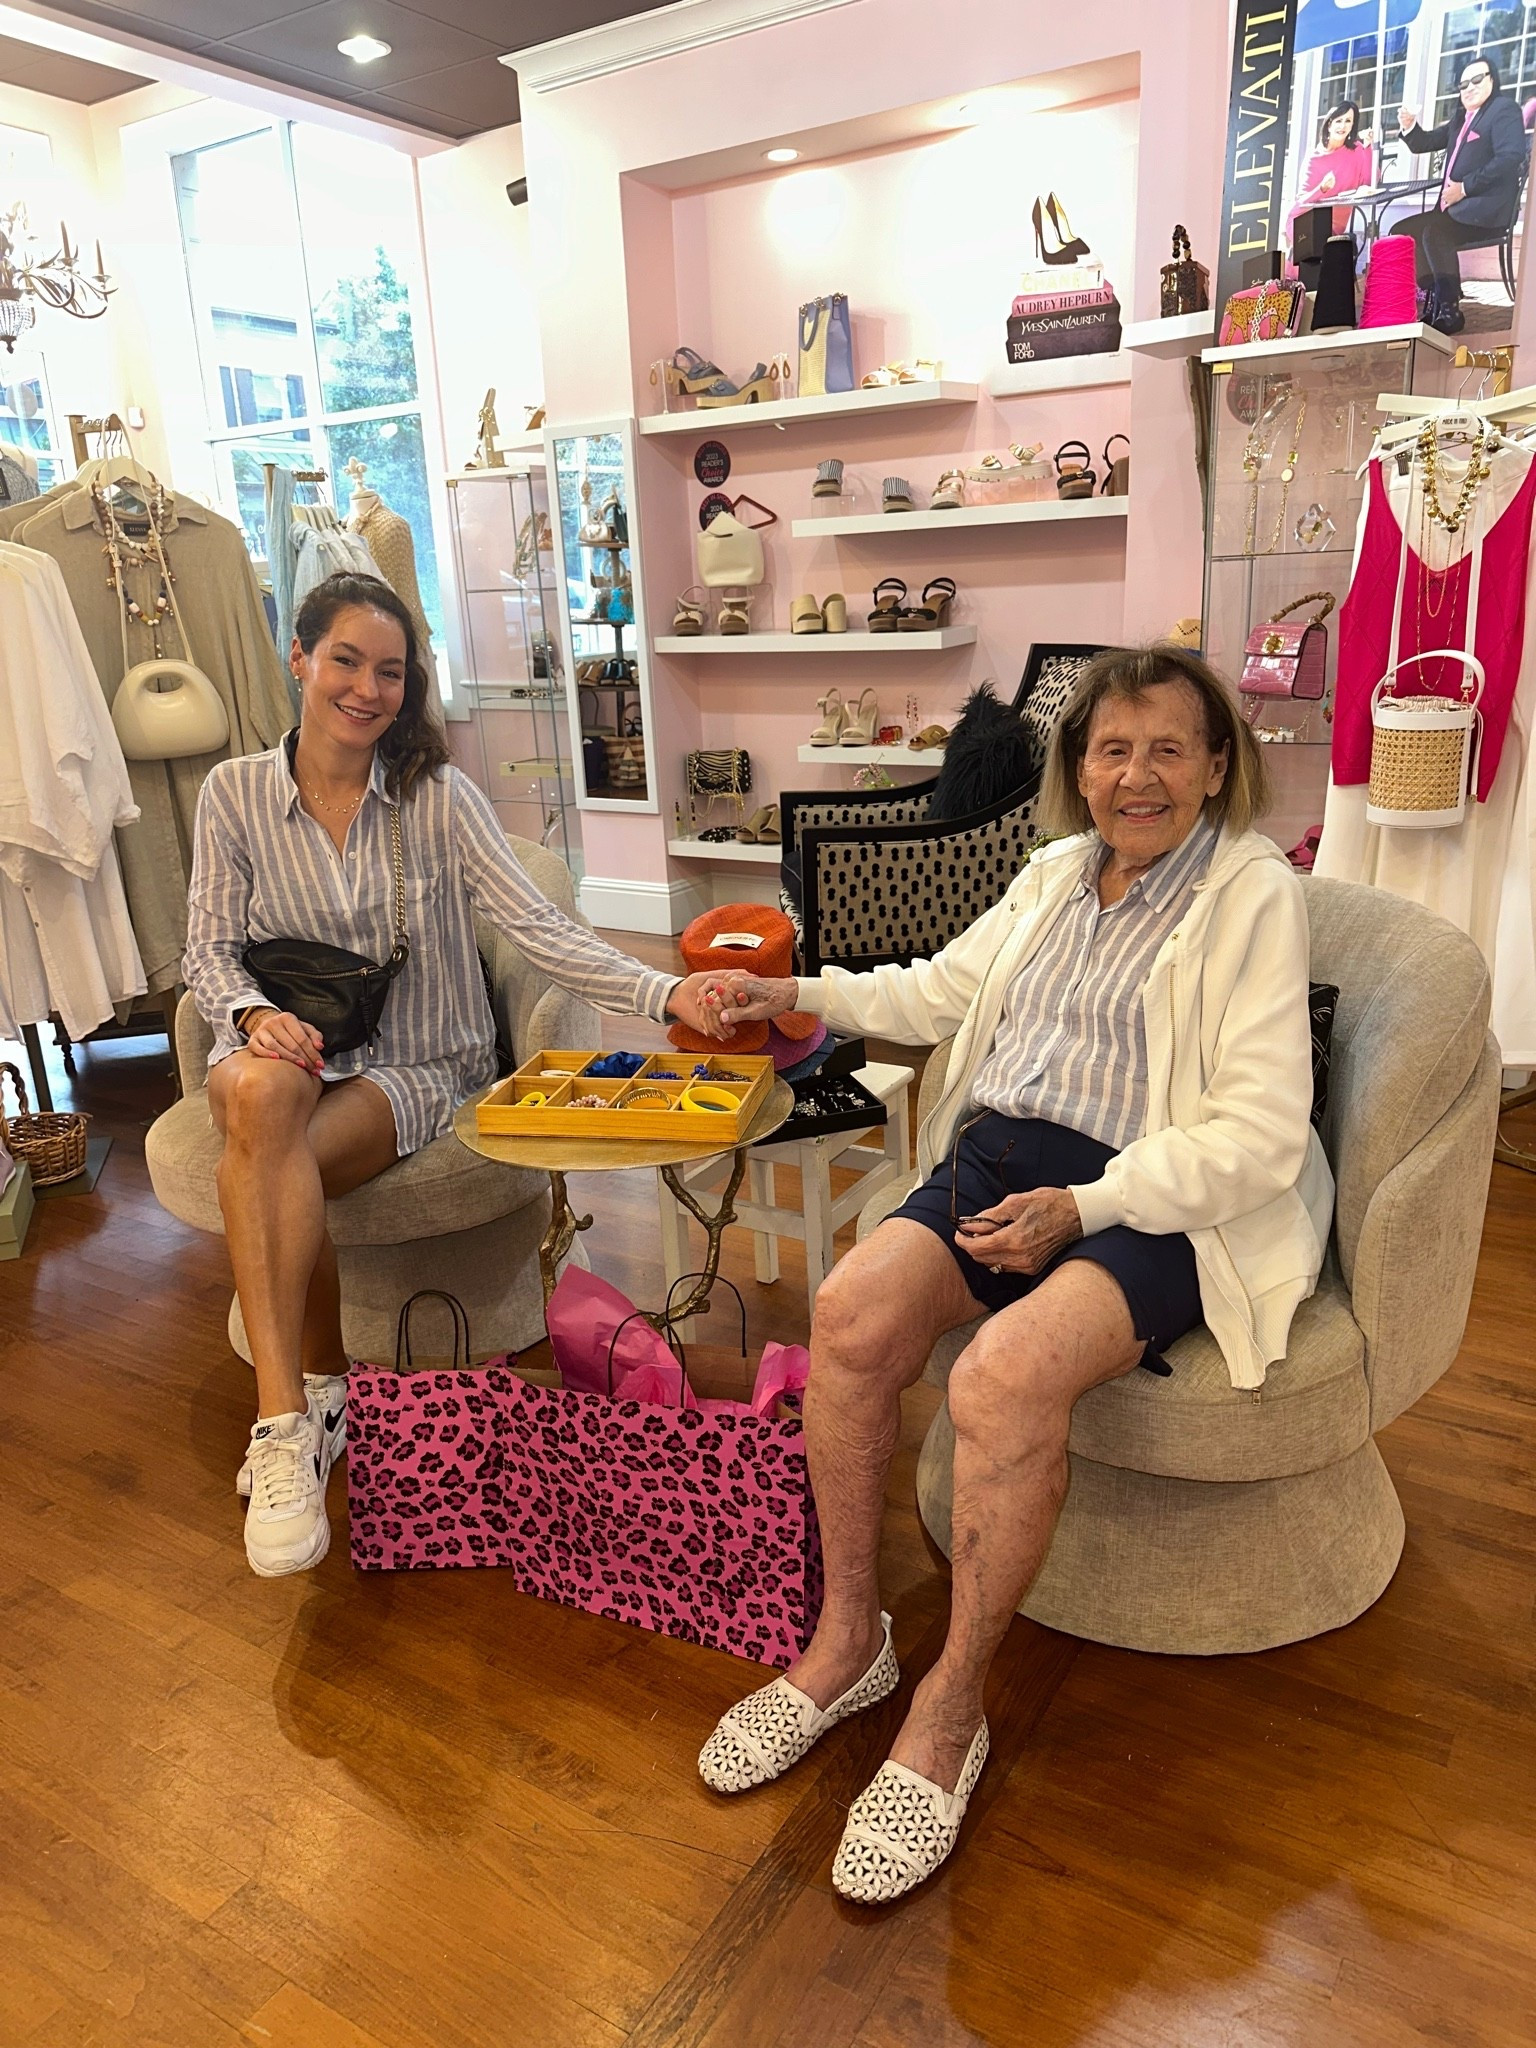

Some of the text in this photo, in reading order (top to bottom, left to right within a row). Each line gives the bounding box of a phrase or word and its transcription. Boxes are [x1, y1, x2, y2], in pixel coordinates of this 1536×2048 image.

[1228, 4, 1288, 258] ELEVATI
[1015, 291, 1110, 315] AUDREY HEPBURN
[1013, 342, 1031, 351] TOM
[1014, 350, 1035, 360] FORD
[257, 1425, 271, 1435] NIKE
